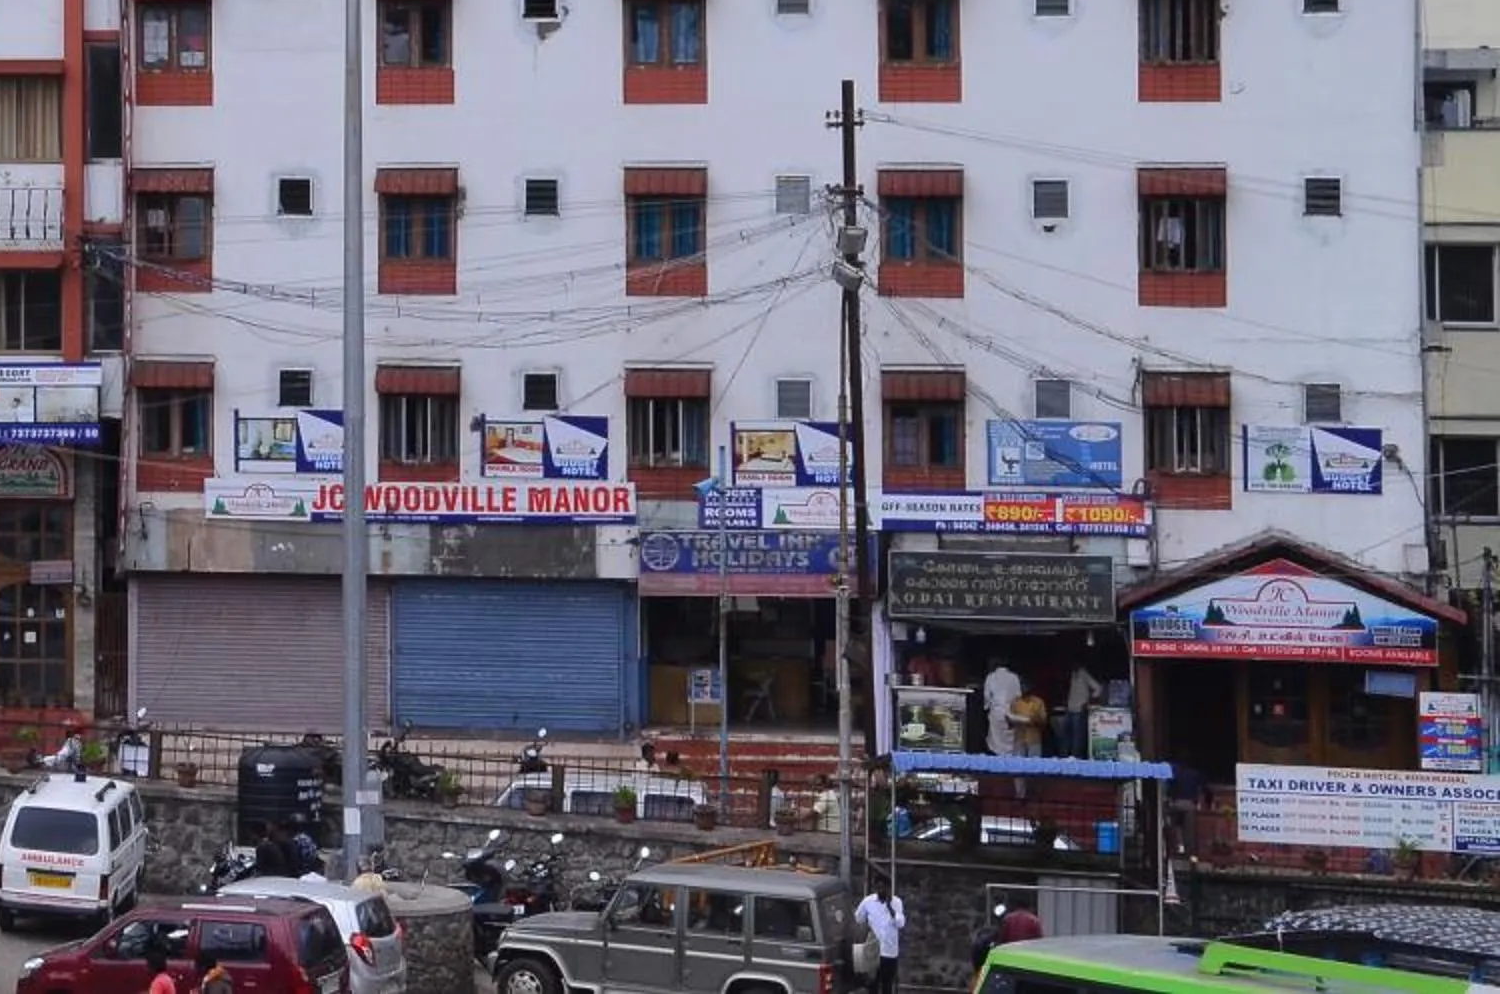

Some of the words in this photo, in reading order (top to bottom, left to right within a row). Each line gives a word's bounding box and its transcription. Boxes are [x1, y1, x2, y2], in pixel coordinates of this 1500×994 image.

[562, 467, 599, 476] HOTEL
[815, 473, 852, 483] HOTL
[1332, 482, 1372, 491] HOTEL
[363, 486, 517, 513] WOODVILLE
[528, 487, 631, 513] MANOR
[679, 534, 771, 549] TRAVEL
[692, 551, 810, 567] HOLIDAYS
[1247, 777, 1283, 790] TAXI
[1287, 779, 1347, 793] DRIVER
[1351, 782, 1363, 793] &
[1367, 782, 1437, 797] OWNERS
